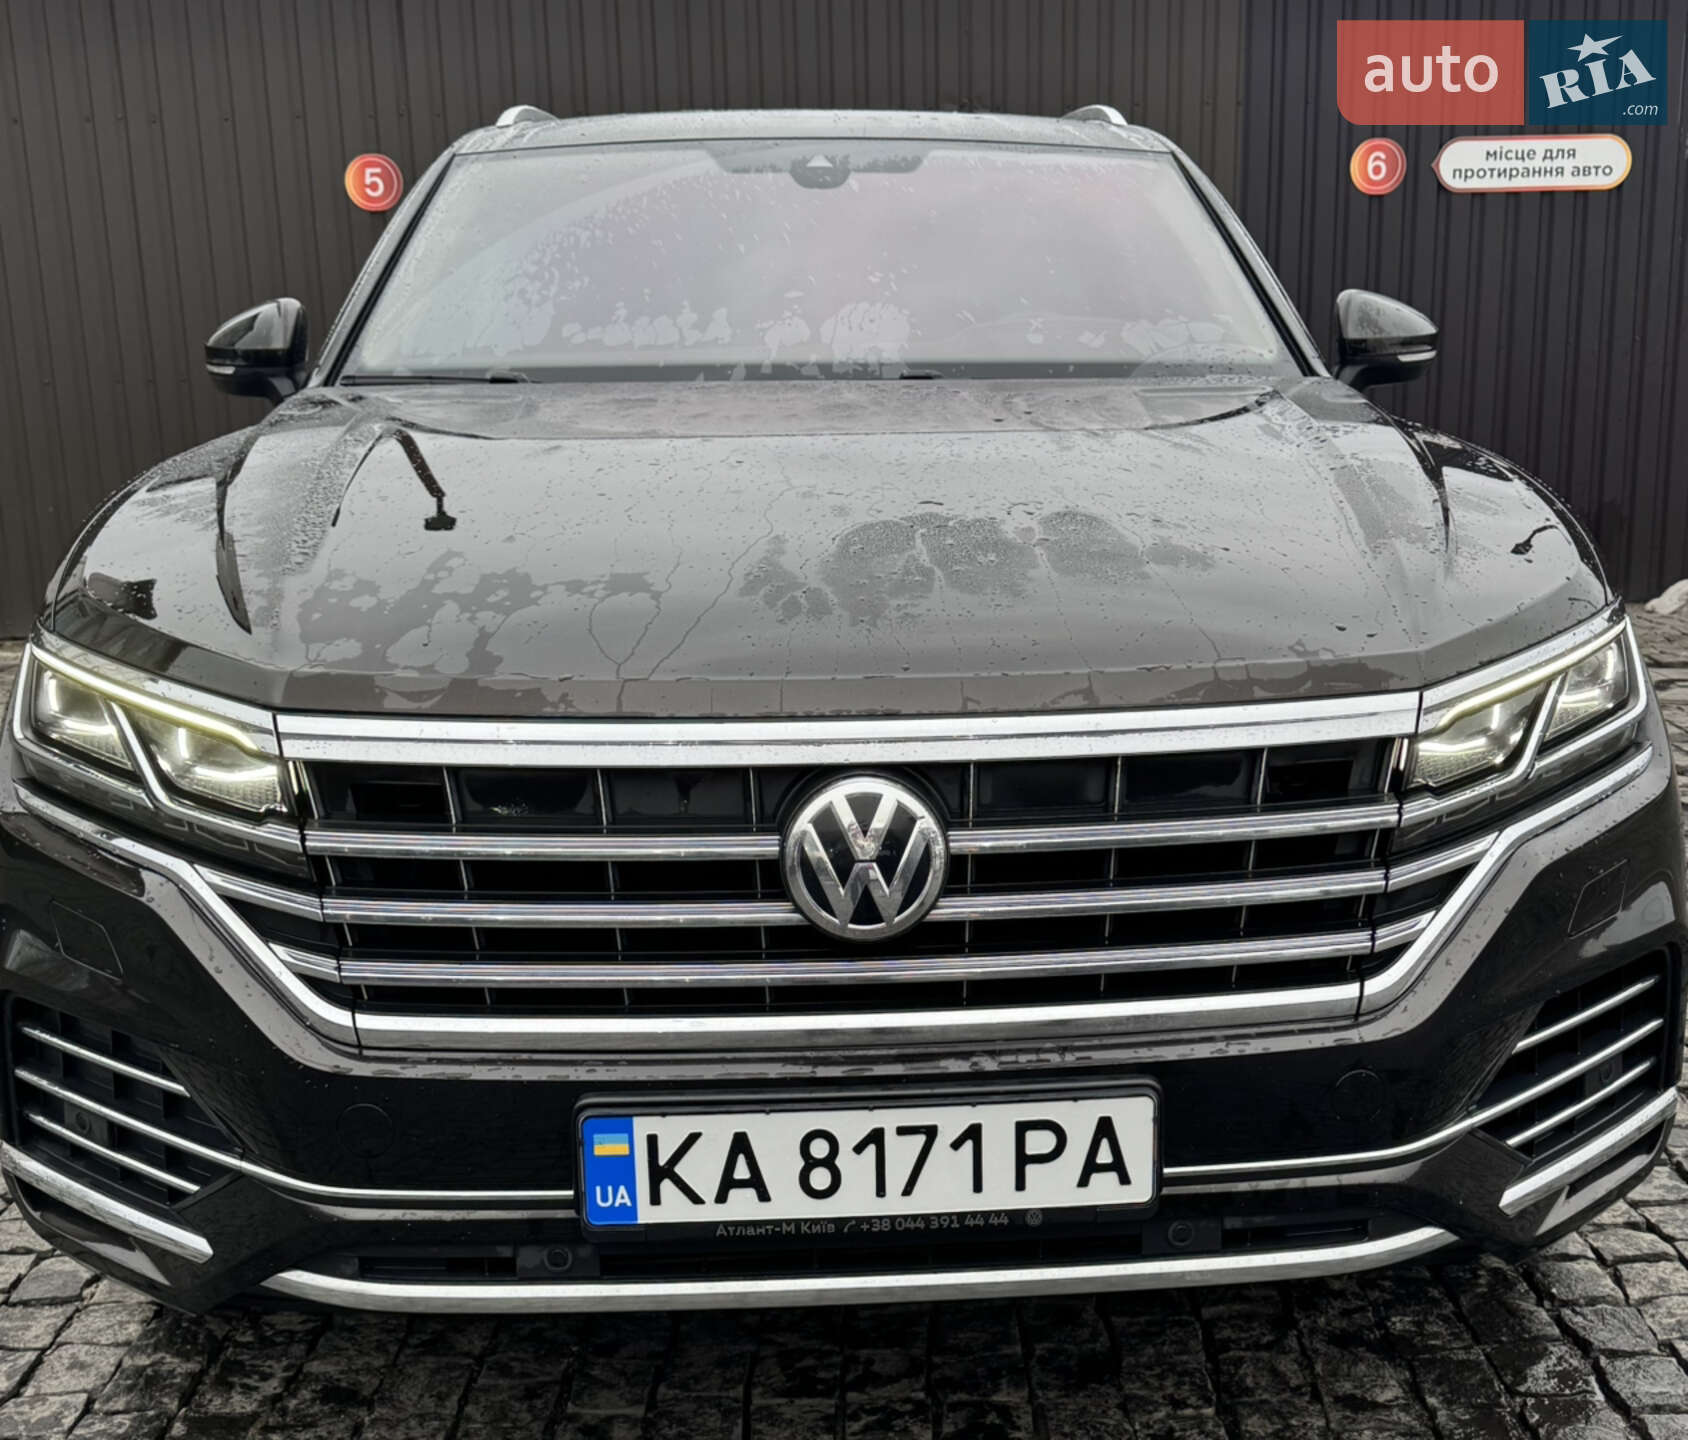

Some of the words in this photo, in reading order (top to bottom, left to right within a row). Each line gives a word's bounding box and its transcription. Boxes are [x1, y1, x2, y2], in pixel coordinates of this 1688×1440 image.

[1485, 146, 1536, 163] місце
[1542, 148, 1577, 161] для
[1367, 151, 1387, 181] 6
[1452, 165, 1565, 182] протирання
[1571, 163, 1613, 178] авто
[364, 167, 385, 197] 5
[646, 1130, 773, 1206] KA
[798, 1122, 983, 1199] 8171
[1014, 1115, 1132, 1191] PA
[596, 1186, 632, 1207] UA
[800, 1220, 836, 1234] Київ
[860, 1217, 891, 1232] +38
[895, 1216, 925, 1231] 044
[929, 1215, 960, 1229] 391
[964, 1213, 985, 1227] 44
[988, 1211, 1009, 1226] 44
